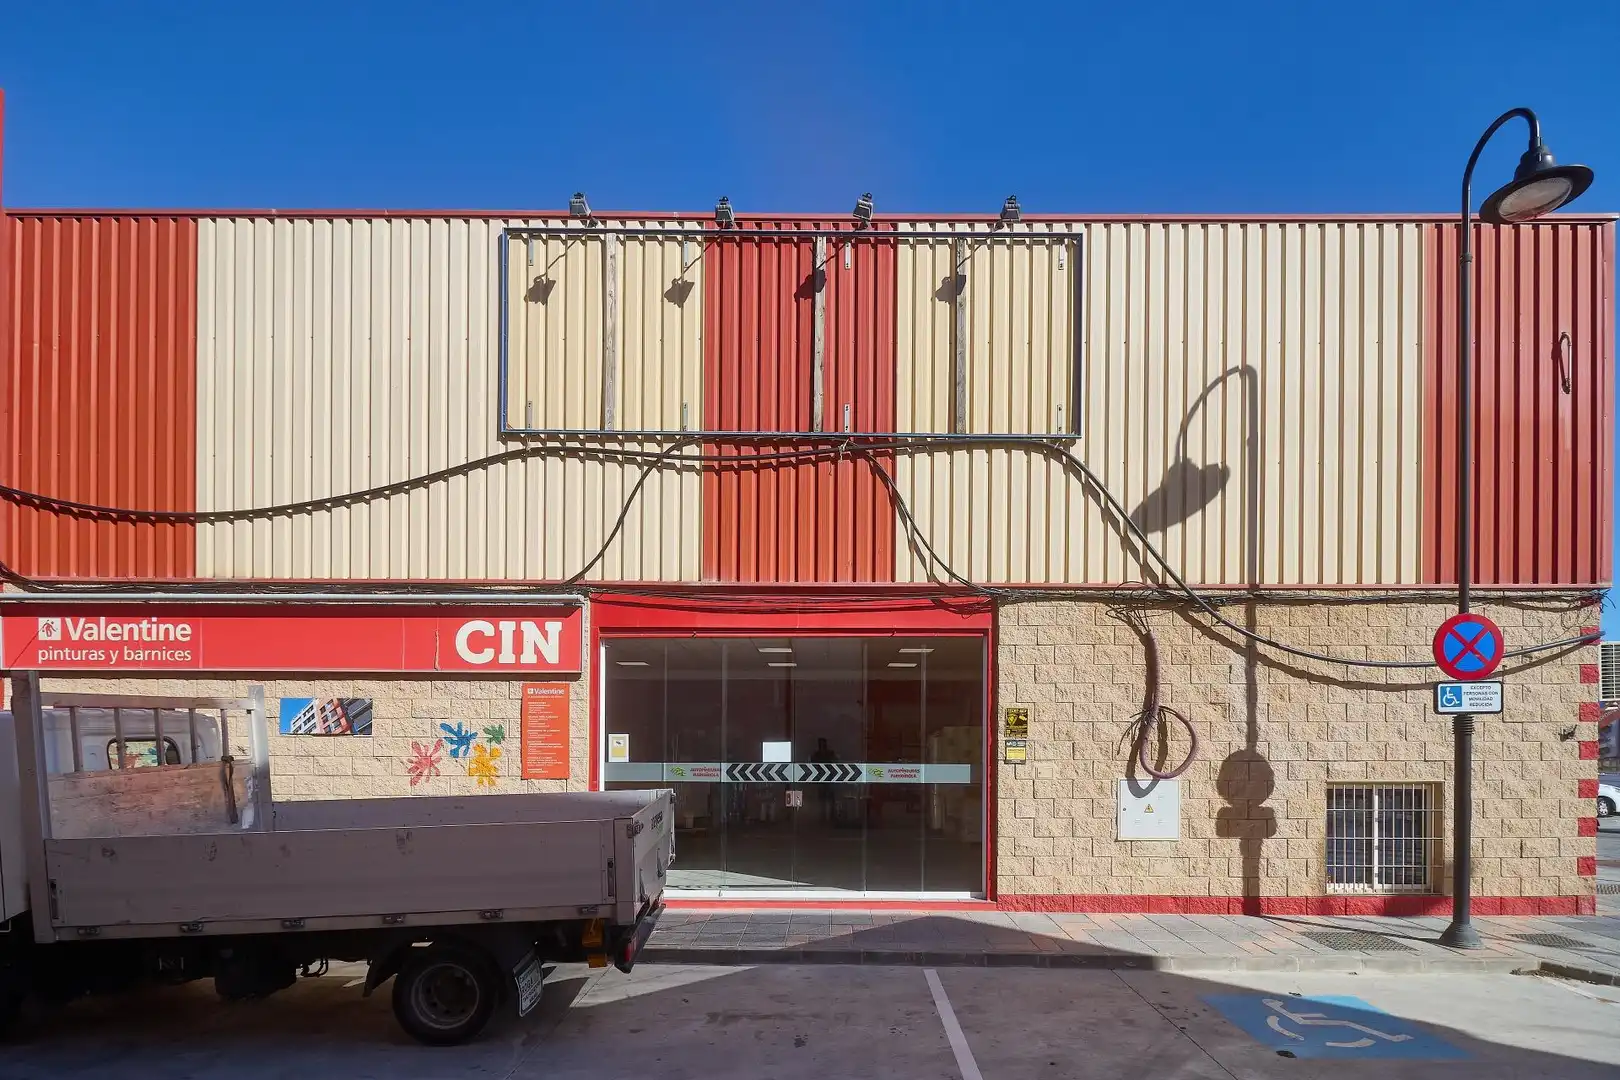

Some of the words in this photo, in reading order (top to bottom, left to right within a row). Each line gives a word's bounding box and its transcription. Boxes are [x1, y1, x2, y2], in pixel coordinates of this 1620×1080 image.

[64, 616, 192, 641] Valentine
[455, 620, 562, 664] CIN
[38, 646, 105, 664] pinturas
[109, 649, 119, 664] y
[124, 646, 192, 661] barnices
[534, 687, 565, 695] Valentine
